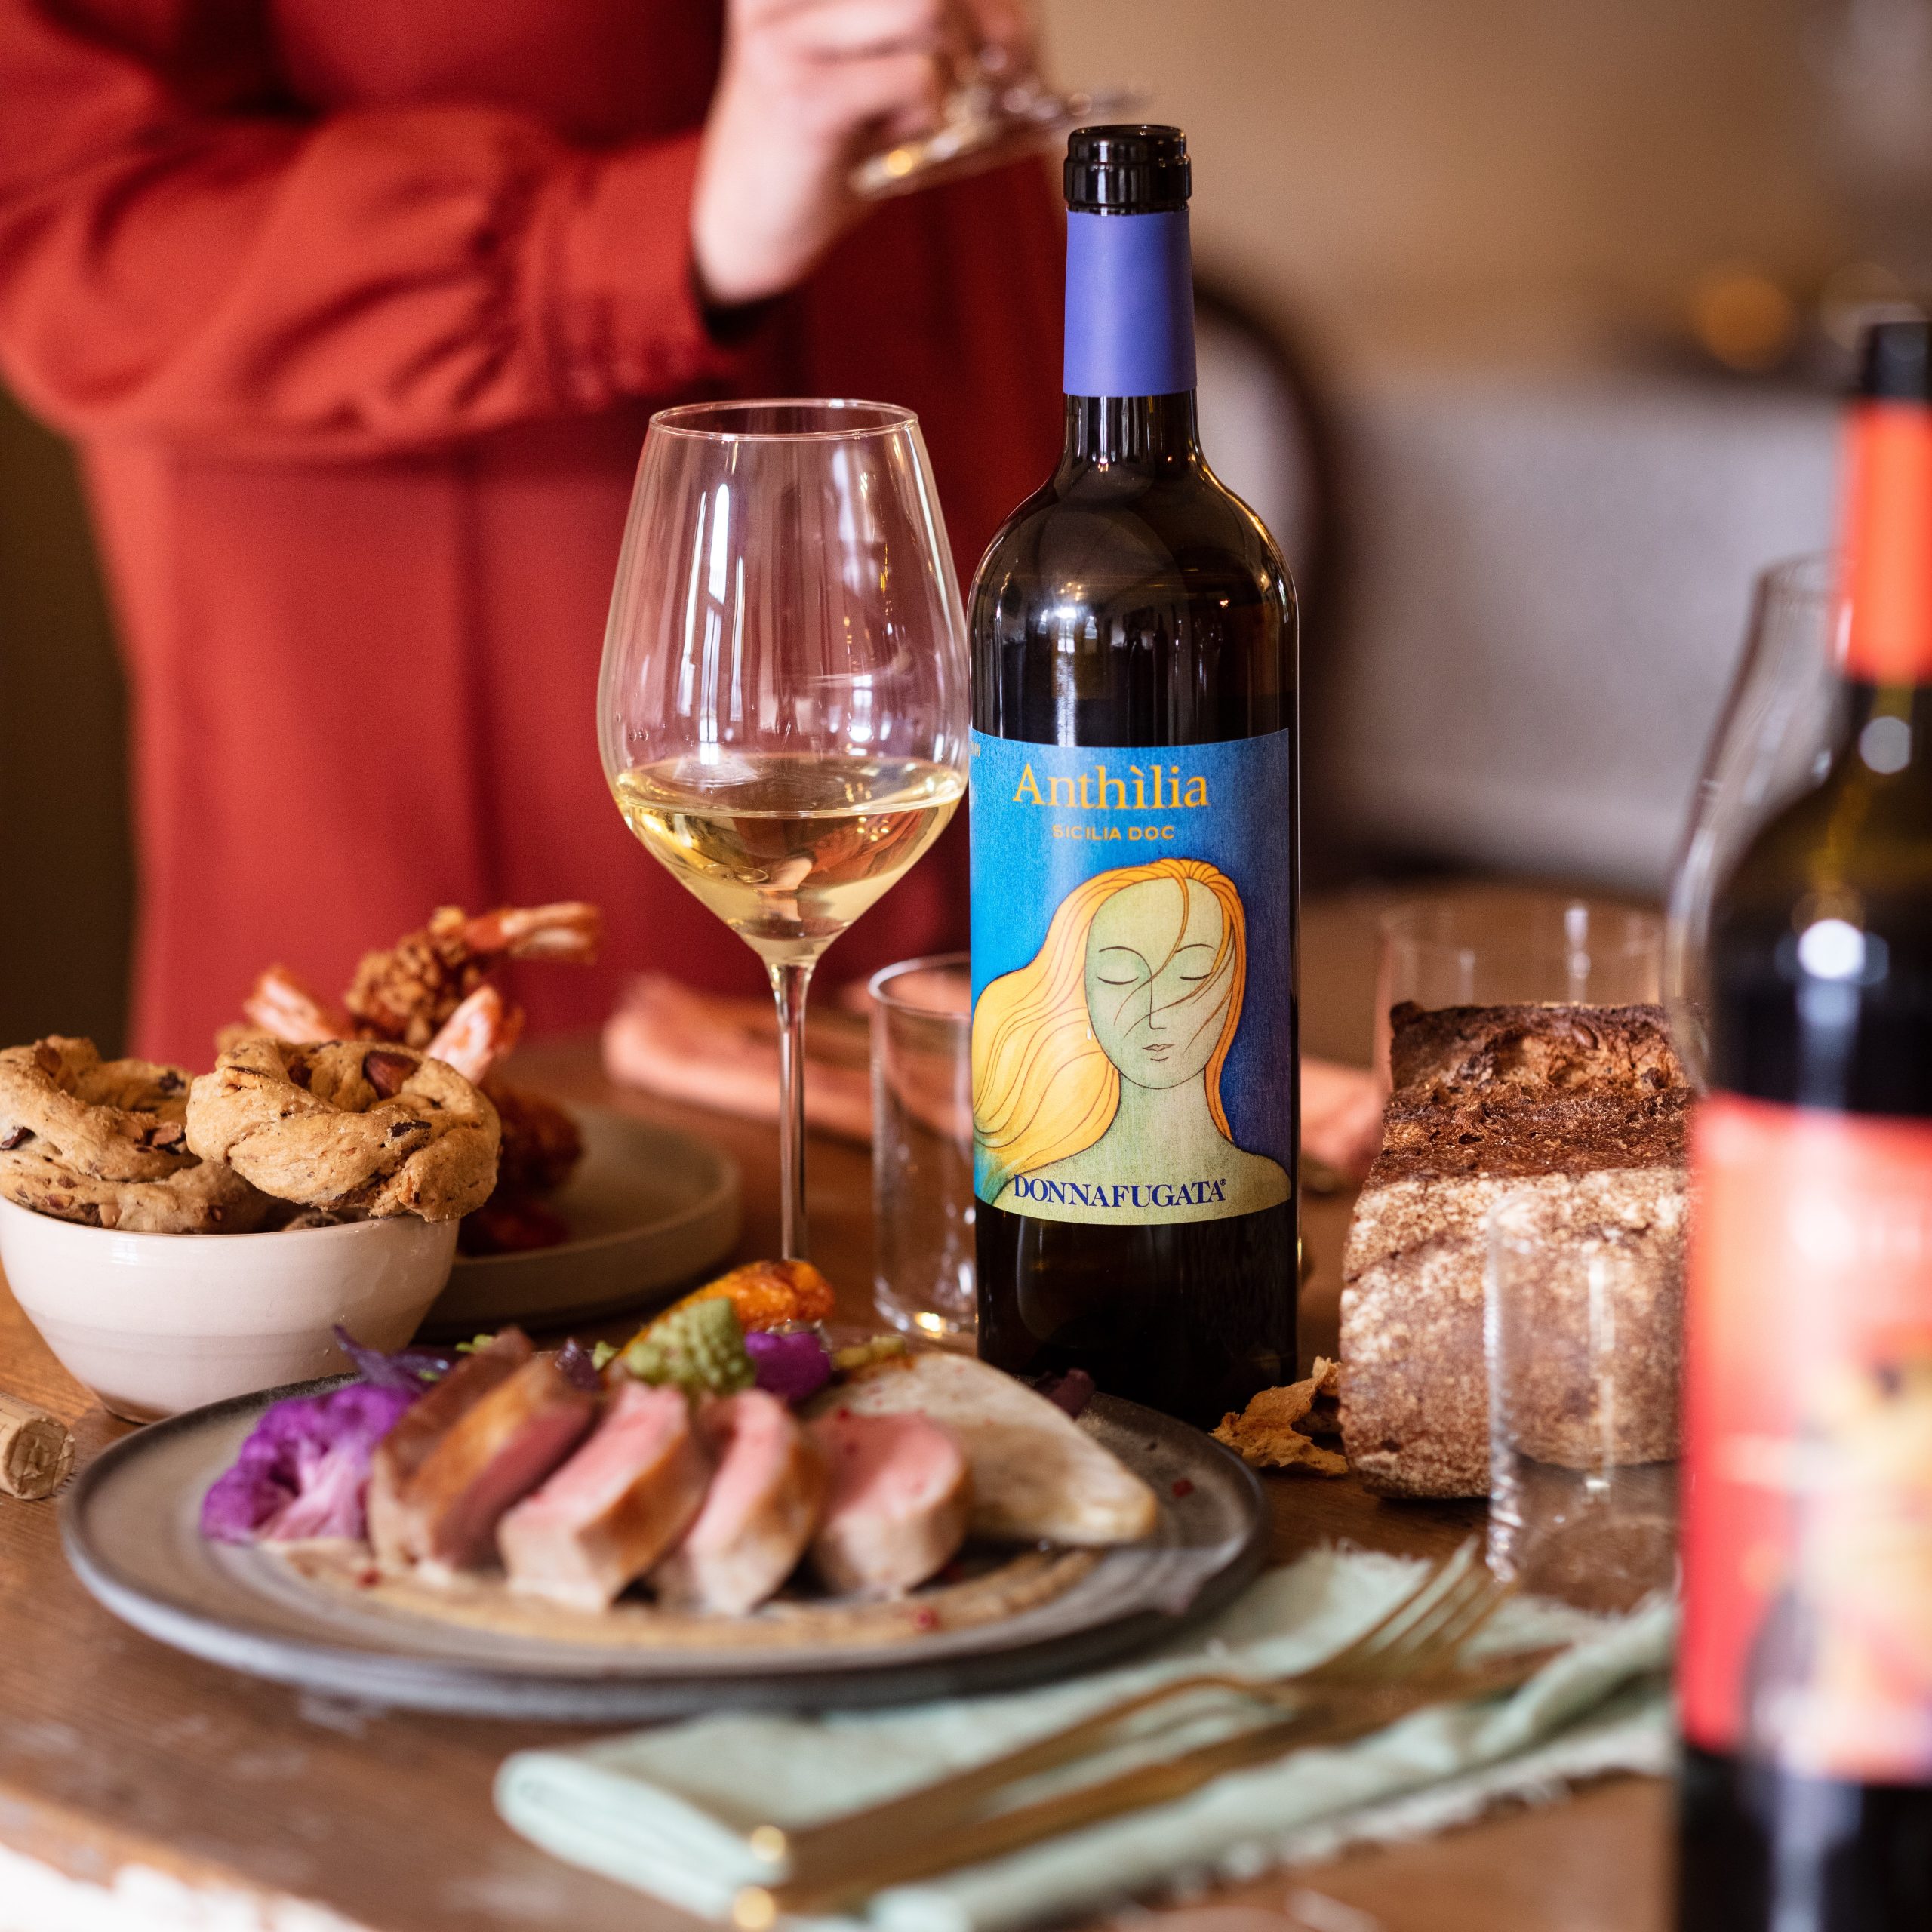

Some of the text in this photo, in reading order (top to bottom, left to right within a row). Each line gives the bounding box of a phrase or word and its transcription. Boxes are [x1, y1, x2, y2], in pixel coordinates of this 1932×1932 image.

[1013, 763, 1209, 809] Anthìlia
[1052, 825, 1175, 841] SICILIA DOC
